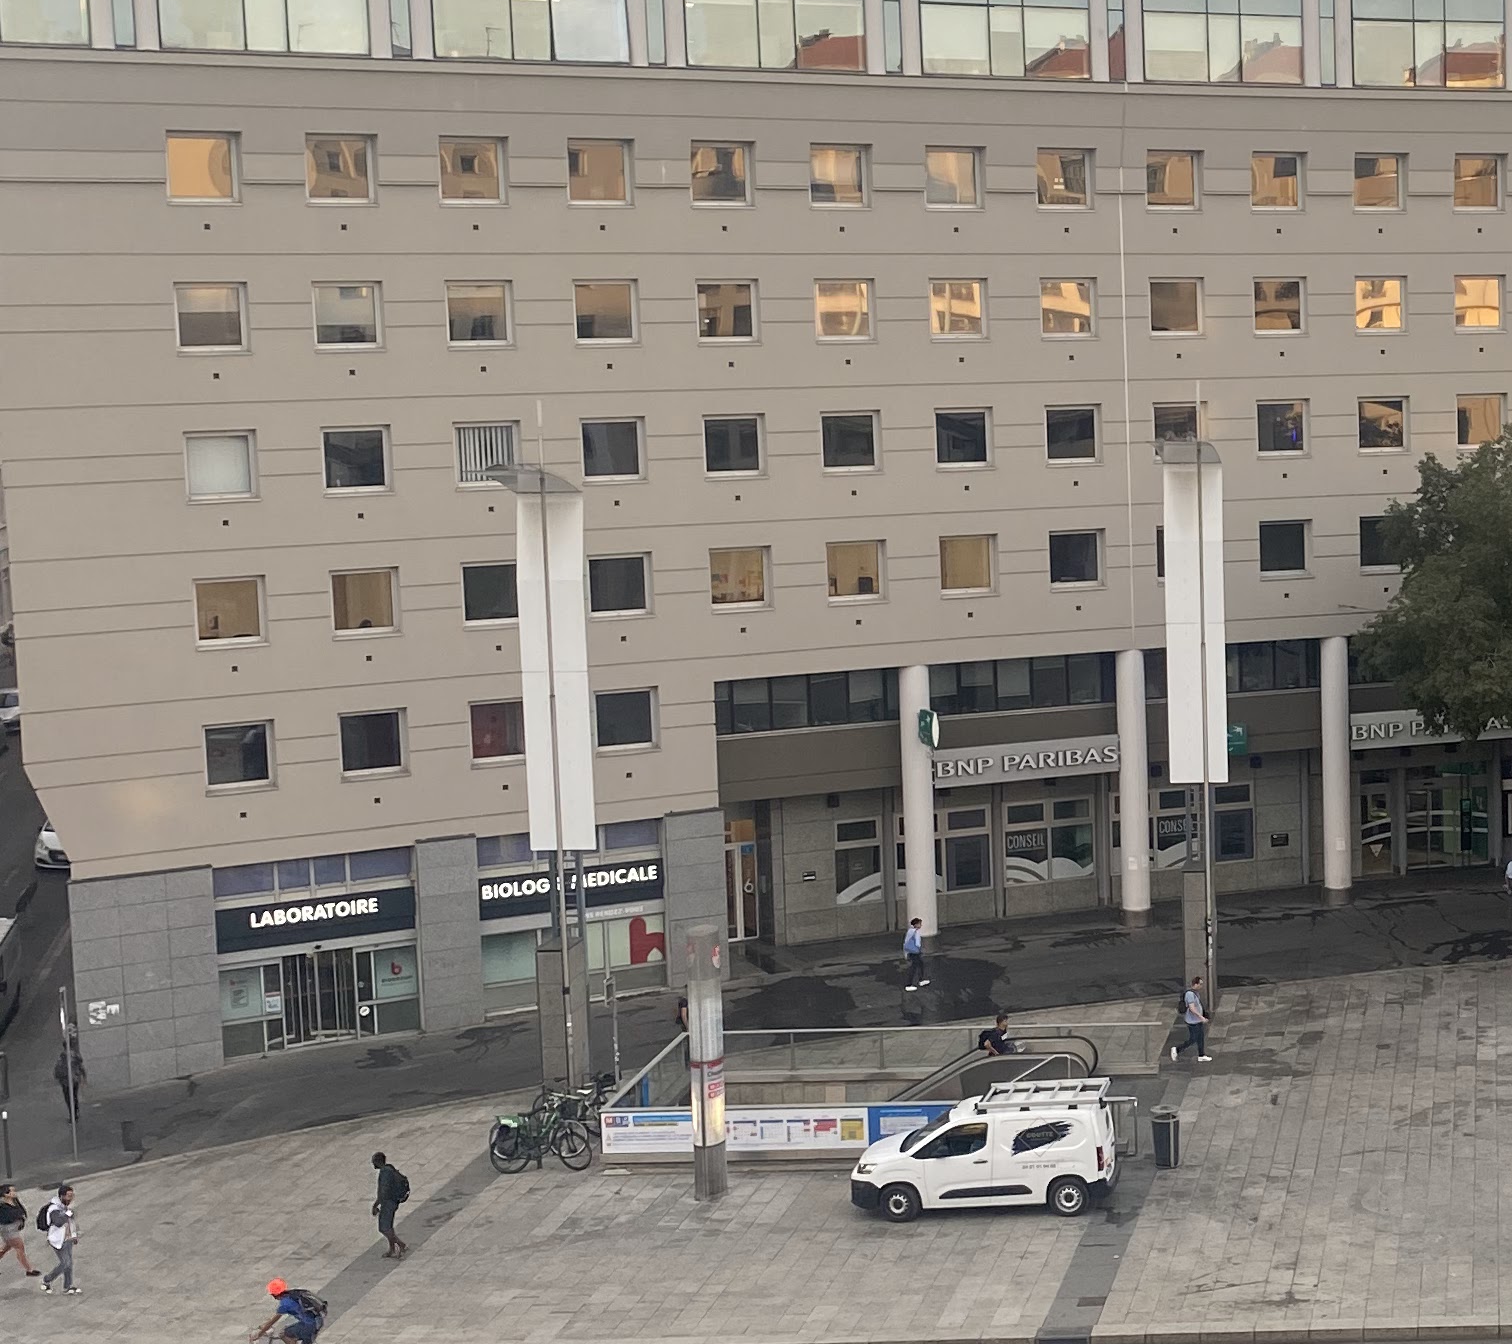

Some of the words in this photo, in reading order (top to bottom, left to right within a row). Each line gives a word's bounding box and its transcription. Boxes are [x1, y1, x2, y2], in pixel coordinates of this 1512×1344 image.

[1351, 722, 1404, 741] BNP
[936, 757, 994, 778] BNP
[1003, 746, 1118, 772] PARIBAS
[1007, 833, 1045, 850] CONSEIL
[481, 877, 564, 900] BIOLOG
[744, 878, 754, 893] 6
[250, 897, 379, 928] LABORATOIRE
